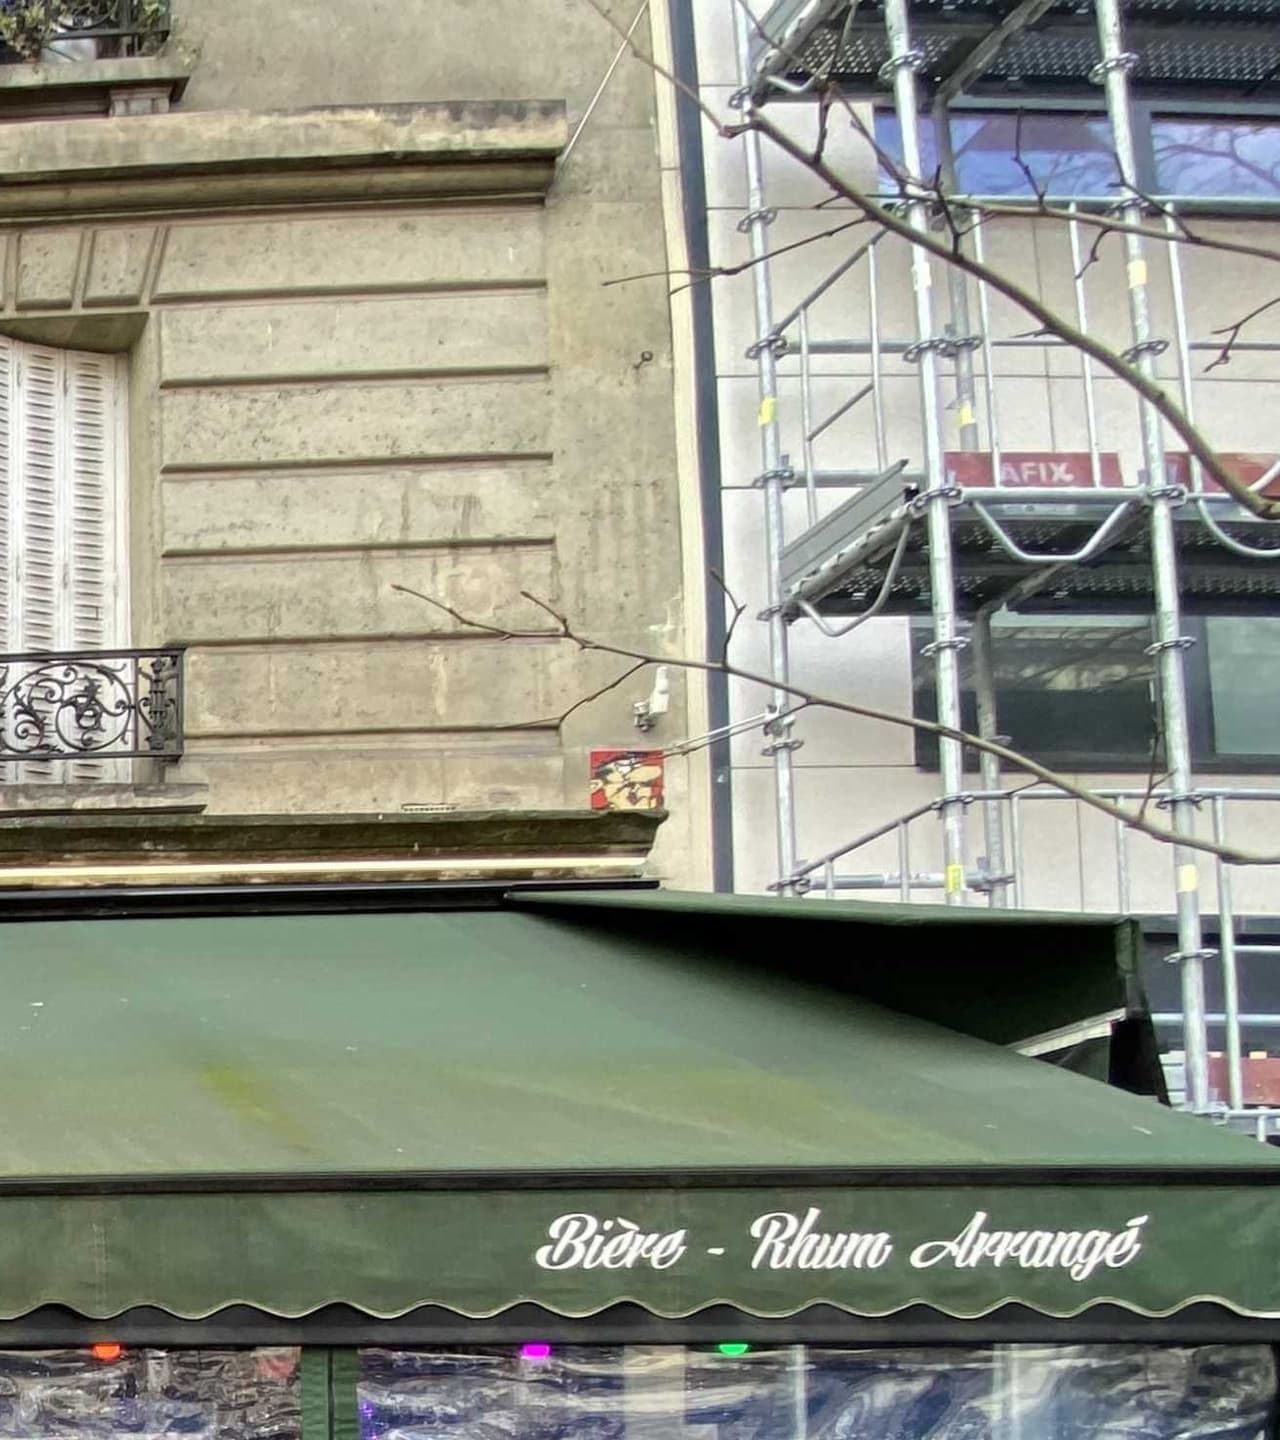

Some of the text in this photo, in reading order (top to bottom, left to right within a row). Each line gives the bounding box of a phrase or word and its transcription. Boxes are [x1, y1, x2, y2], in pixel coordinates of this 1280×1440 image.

[535, 1212, 686, 1271] Bière
[750, 1207, 893, 1271] Rhum
[910, 1209, 1150, 1281] Arrangé
